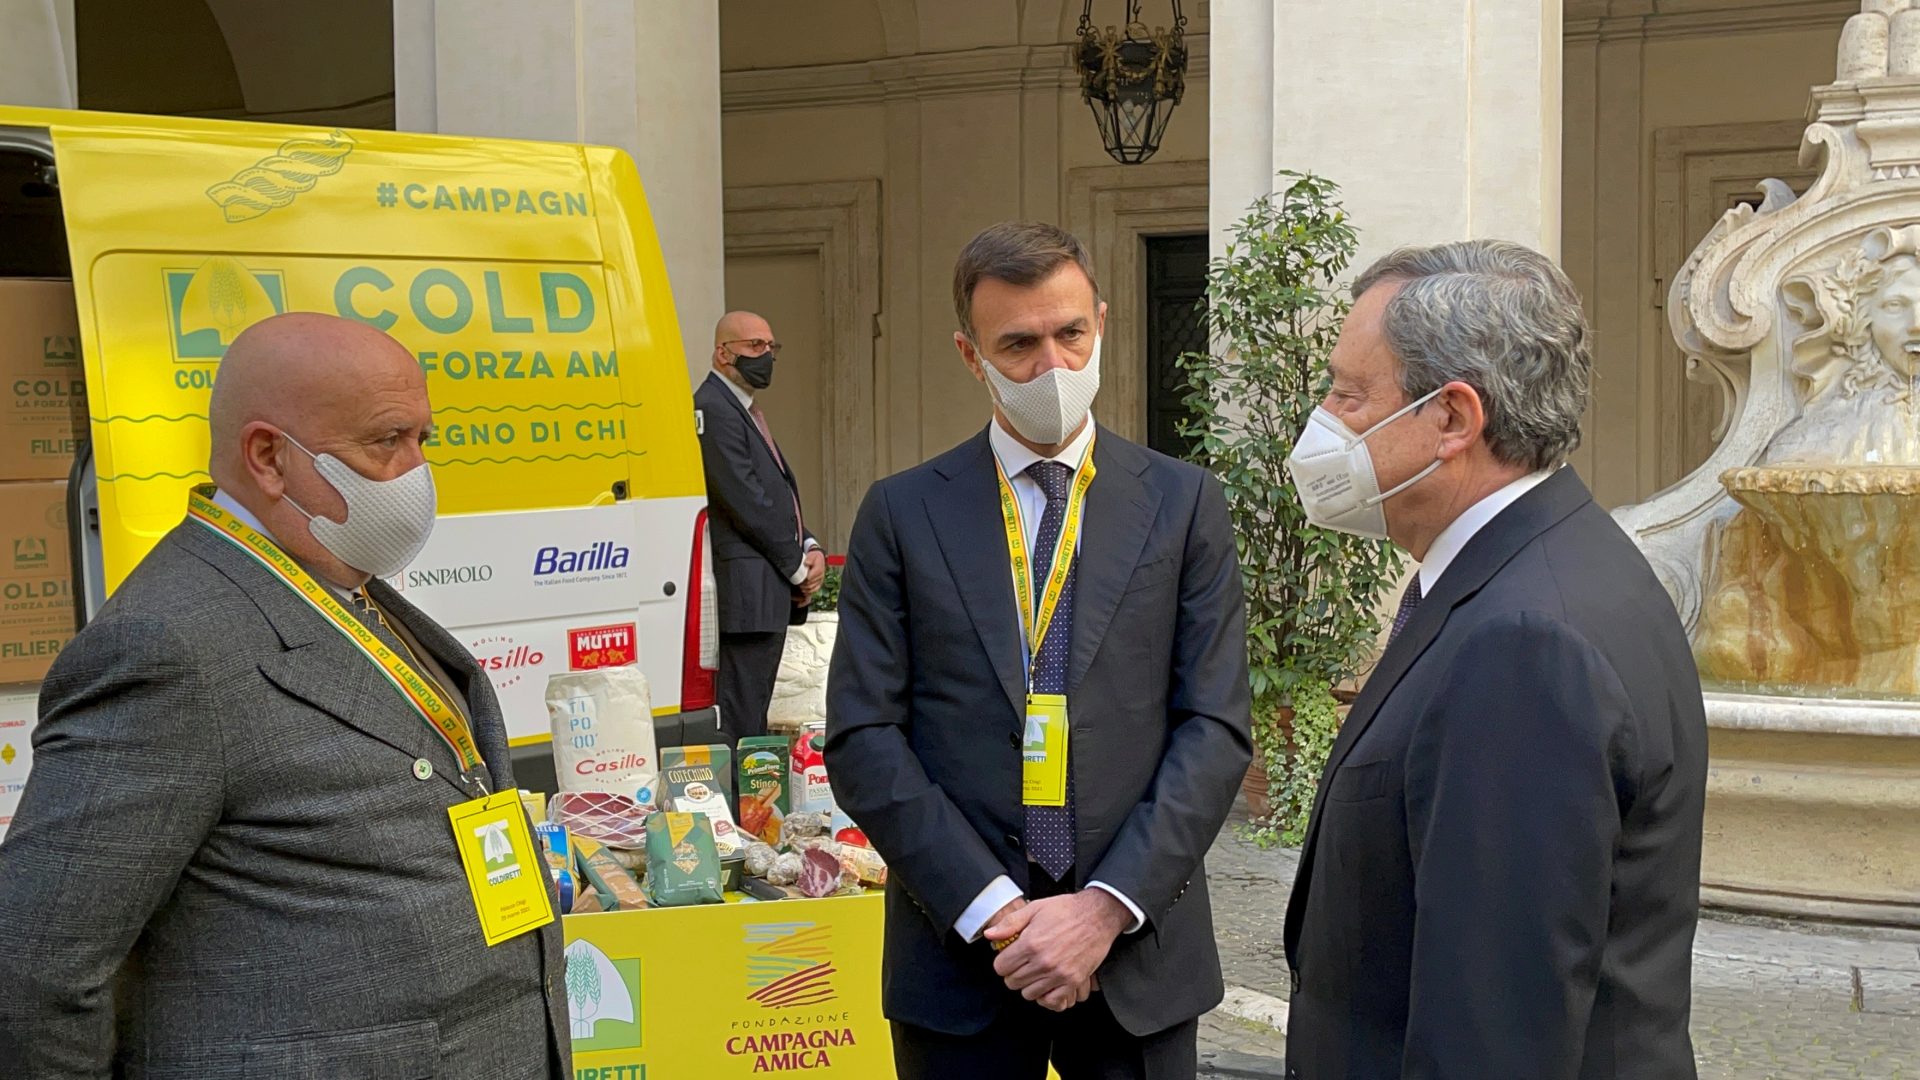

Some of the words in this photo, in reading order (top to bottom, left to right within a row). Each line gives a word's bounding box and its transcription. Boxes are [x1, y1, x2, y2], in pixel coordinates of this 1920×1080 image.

[377, 182, 595, 217] #CAMPAGN
[334, 266, 595, 334] COLD
[418, 351, 554, 380] FORZA
[566, 351, 619, 378] AM
[13, 380, 85, 397] COLD
[531, 421, 560, 442] DI
[575, 420, 626, 440] CHI
[1002, 492, 1017, 533] COLDIRETTI
[246, 532, 299, 577] COLDIRETTI
[533, 541, 630, 576] Barilla
[1054, 539, 1073, 584] COLDIRETTI
[409, 564, 493, 588] SANPAOLO
[1014, 556, 1028, 602] COLDIRETTI
[4, 601, 43, 611] FORZA
[320, 597, 372, 643] COLDIRETTI
[473, 636, 513, 648] MOLINO
[577, 632, 628, 652] MUTTI
[394, 663, 441, 714] COLDIRETTI
[575, 753, 647, 775] Casillo
[750, 779, 778, 789] Stinco
[489, 868, 522, 887] COLDIRETTI
[731, 1011, 850, 1029] FONDAZIONE
[725, 1028, 857, 1055] CAMPAGNA
[752, 1050, 831, 1073] AMICA
